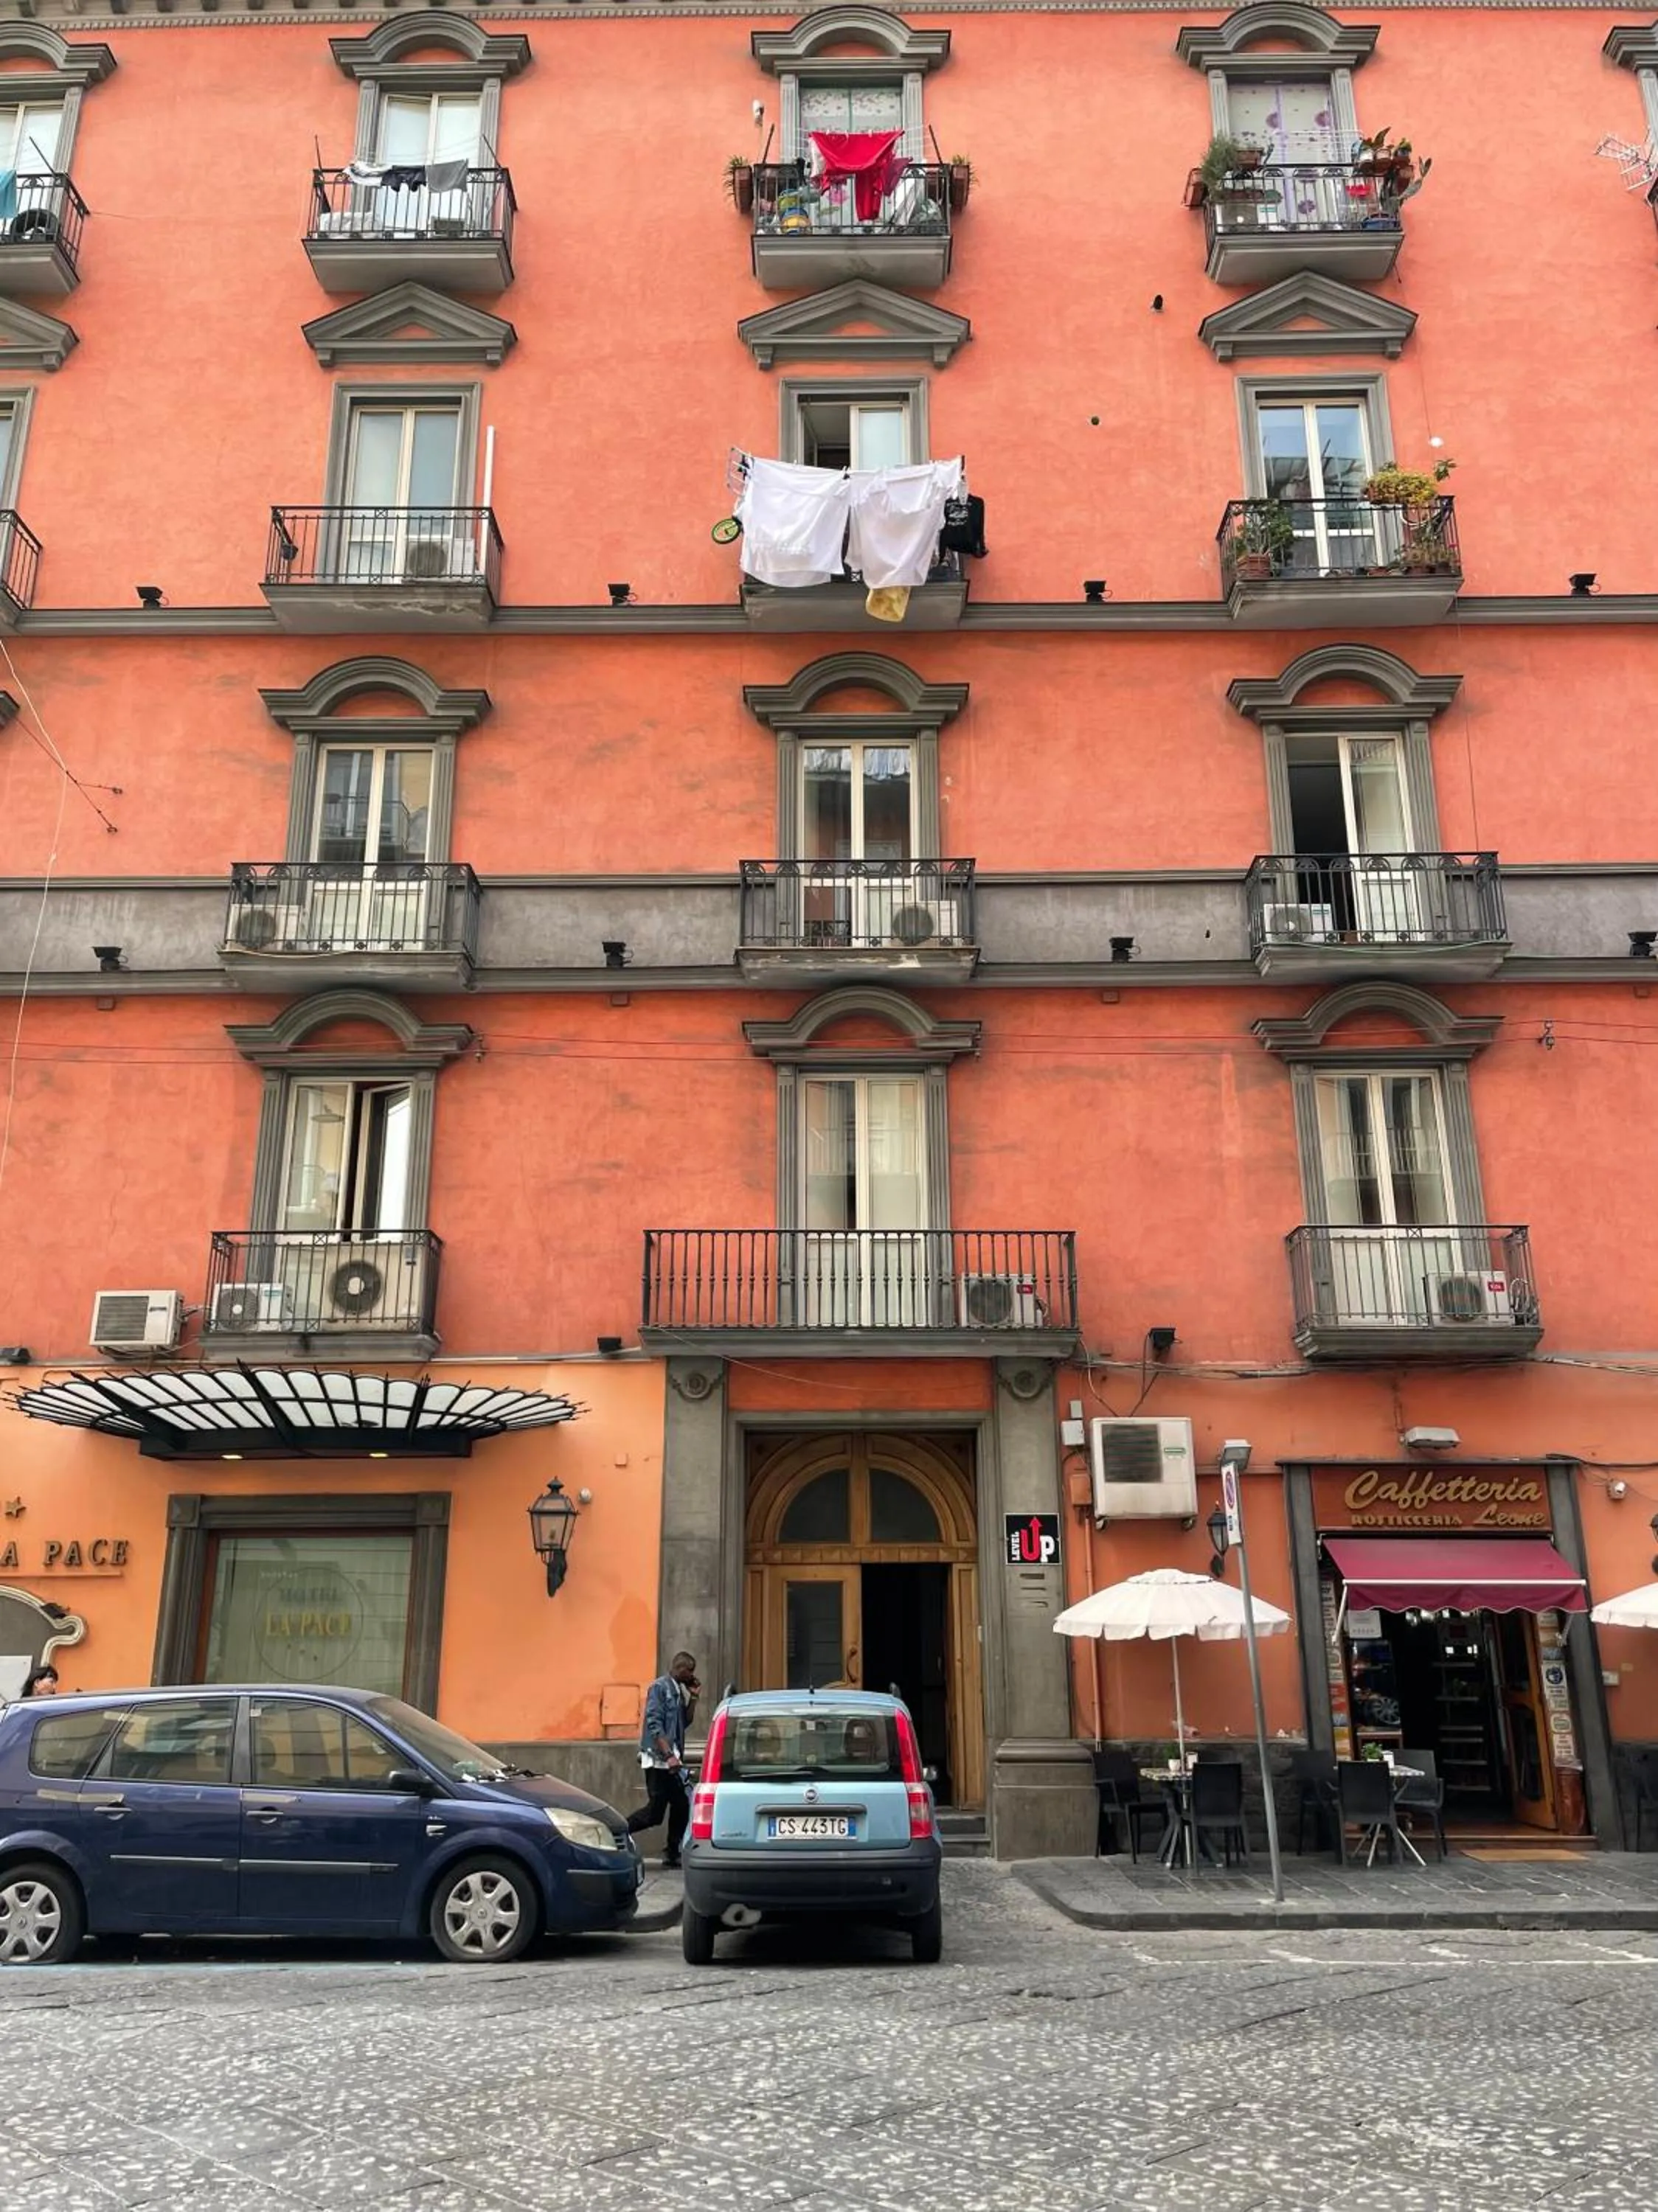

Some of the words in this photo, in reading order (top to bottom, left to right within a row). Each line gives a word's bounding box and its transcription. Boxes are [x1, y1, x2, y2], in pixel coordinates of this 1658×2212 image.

[1345, 1470, 1543, 1509] Caffetteria
[1351, 1514, 1463, 1526] ROSTICCERIA
[1473, 1503, 1546, 1526] Leone
[43, 1539, 128, 1567] PACE
[1011, 1531, 1020, 1561] LEVEL
[1020, 1517, 1055, 1562] UP
